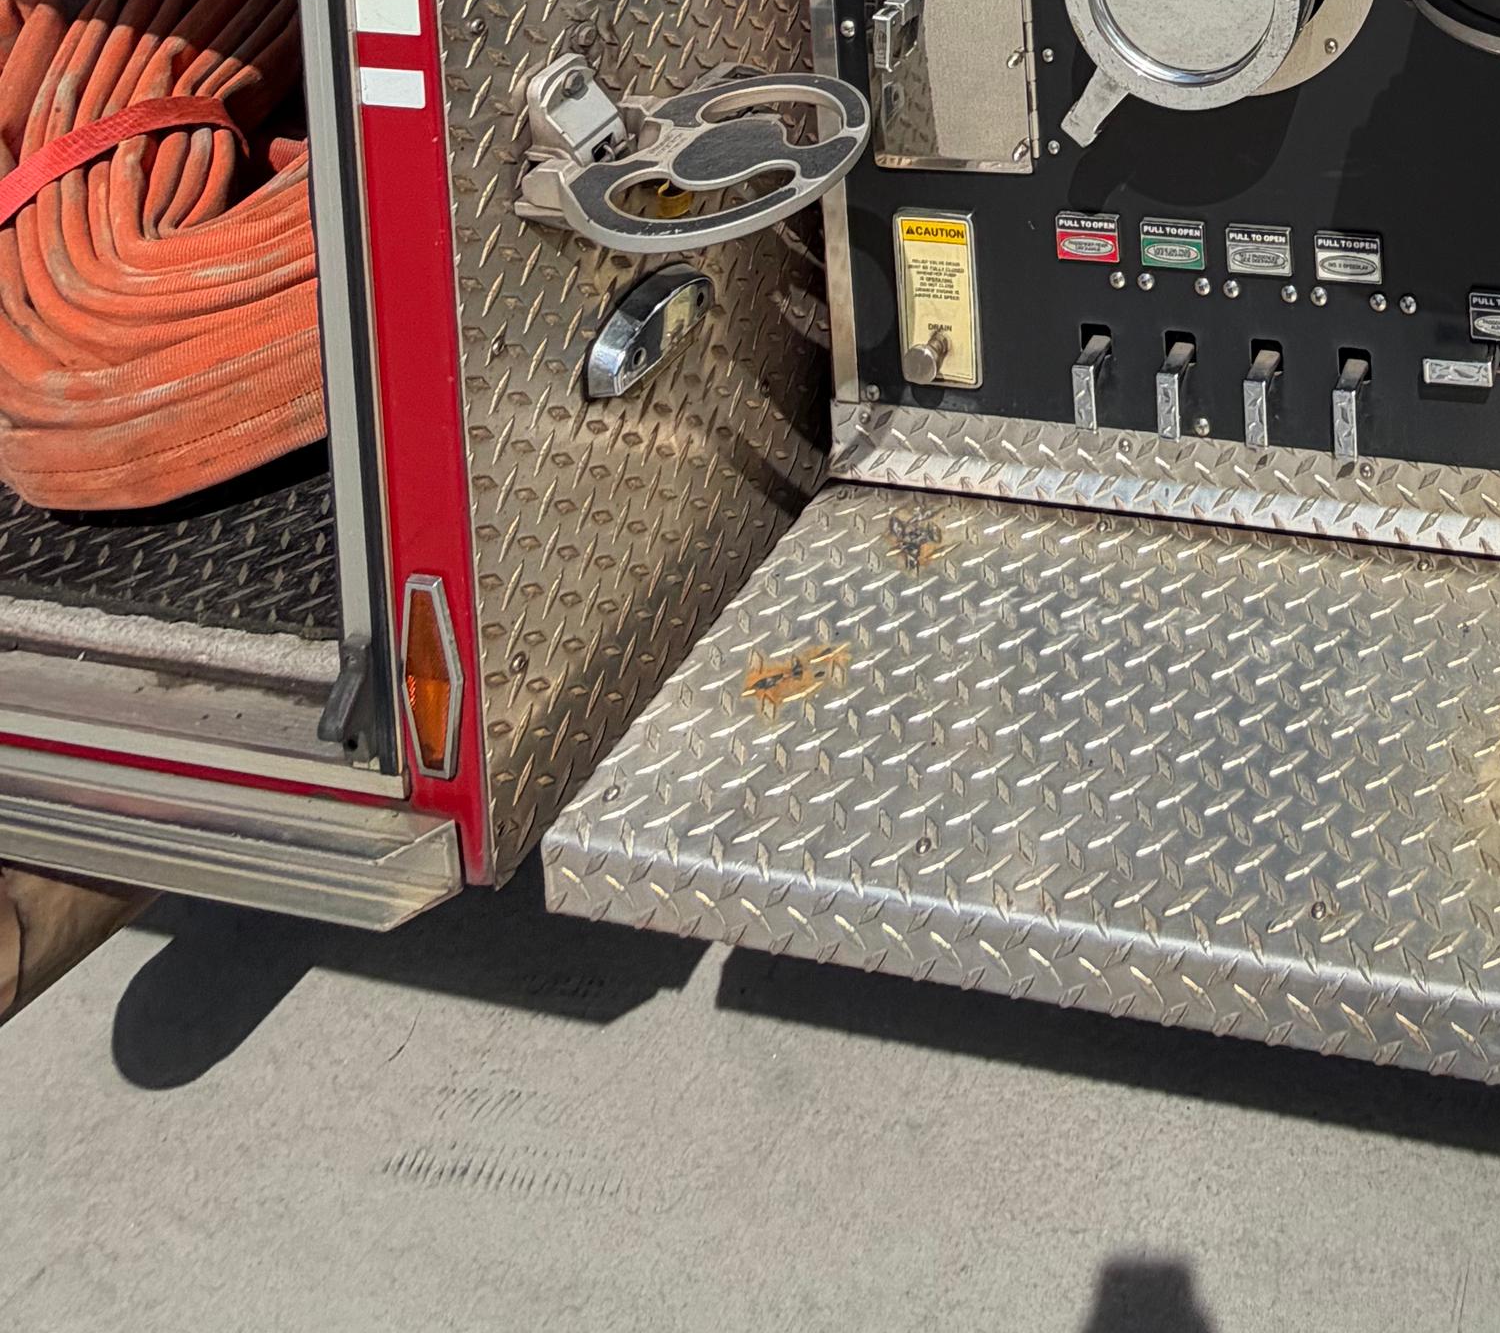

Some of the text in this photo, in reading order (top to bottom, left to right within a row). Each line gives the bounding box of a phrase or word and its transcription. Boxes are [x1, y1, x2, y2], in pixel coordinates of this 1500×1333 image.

[1059, 219, 1115, 229] PULL TO OPEN
[915, 226, 964, 238] CAUTION
[1143, 225, 1200, 236] PULL TO OPEN
[1230, 233, 1286, 243] PULL TO OPEN
[1318, 238, 1377, 250] PULL TO OPEN
[1472, 297, 1495, 306] PULL
[928, 323, 952, 332] DRAIN
